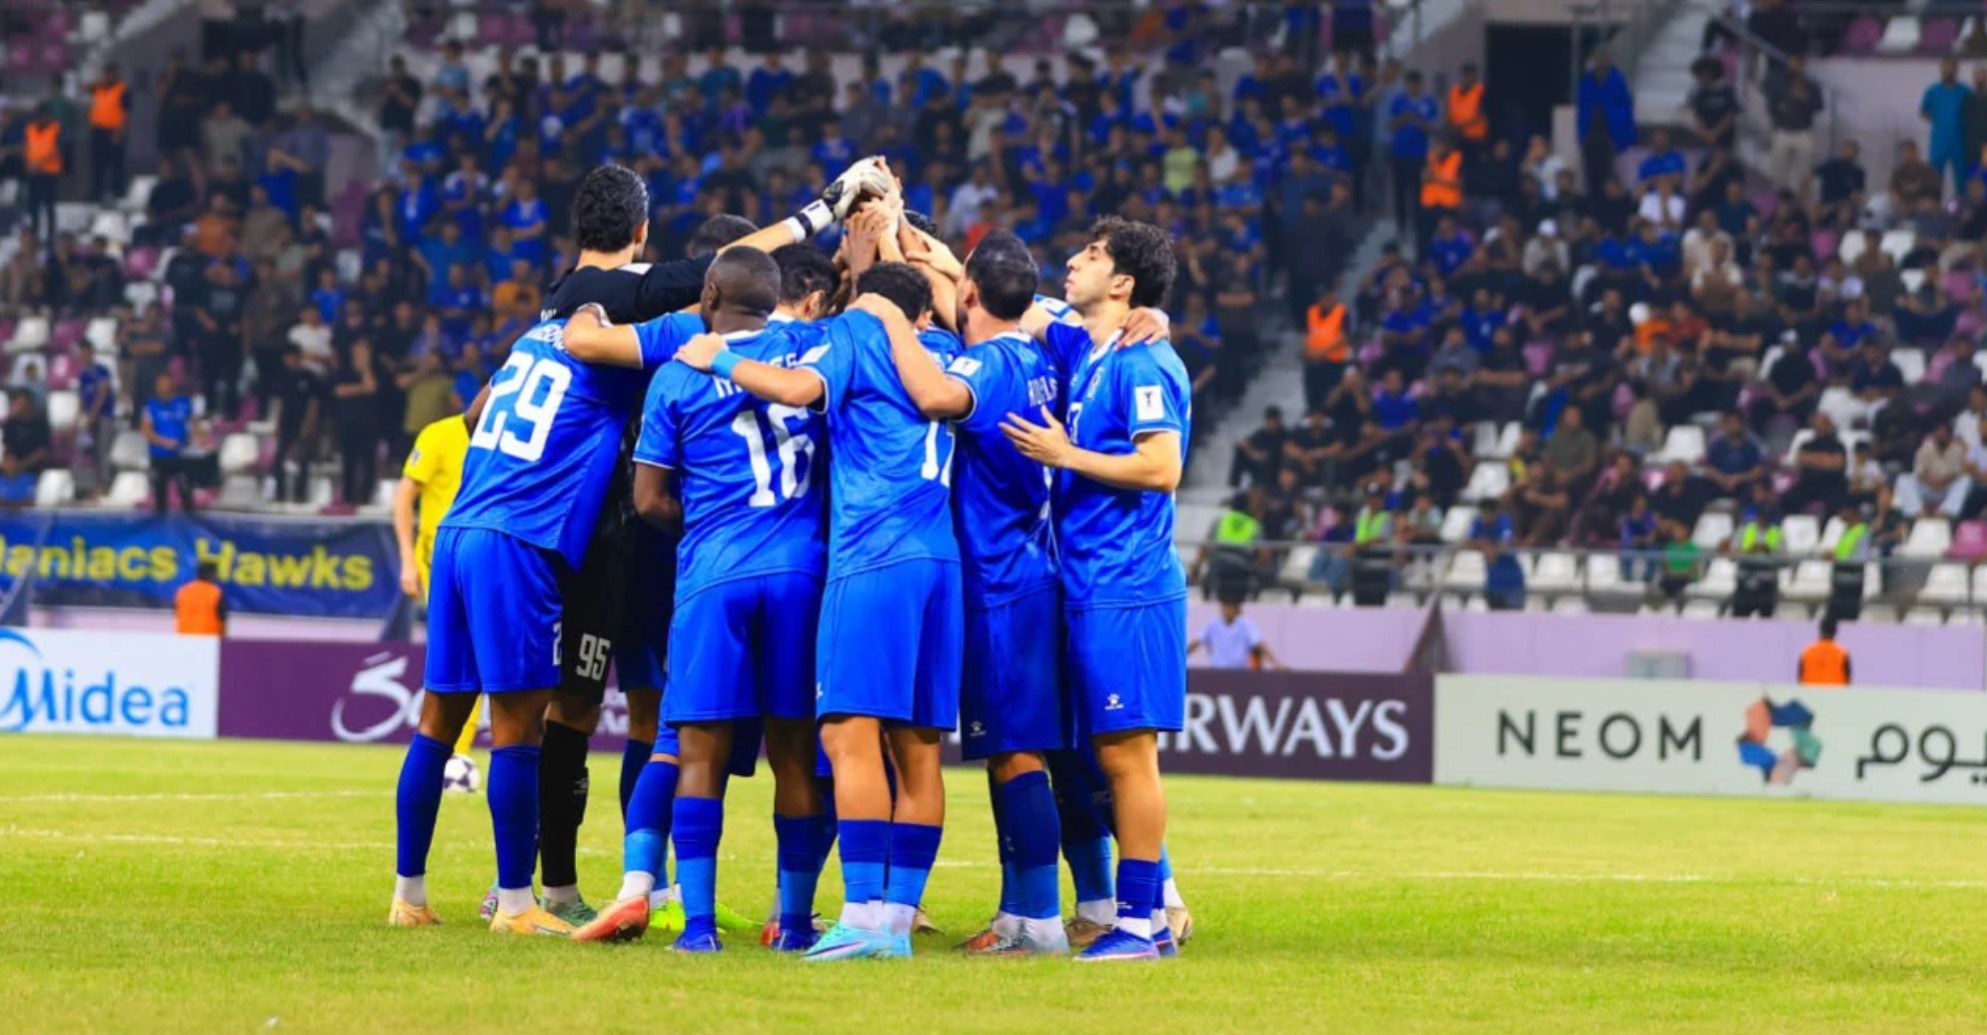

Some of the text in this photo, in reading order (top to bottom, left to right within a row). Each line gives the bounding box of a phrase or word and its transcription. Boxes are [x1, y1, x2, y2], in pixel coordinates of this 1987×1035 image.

[470, 351, 573, 463] 29
[731, 402, 816, 508] 16
[195, 537, 374, 590] Hawks
[576, 633, 611, 681] 95
[0, 667, 190, 733] Midea
[1156, 692, 1409, 760] RWAYS
[1498, 709, 1703, 762] NEOM
